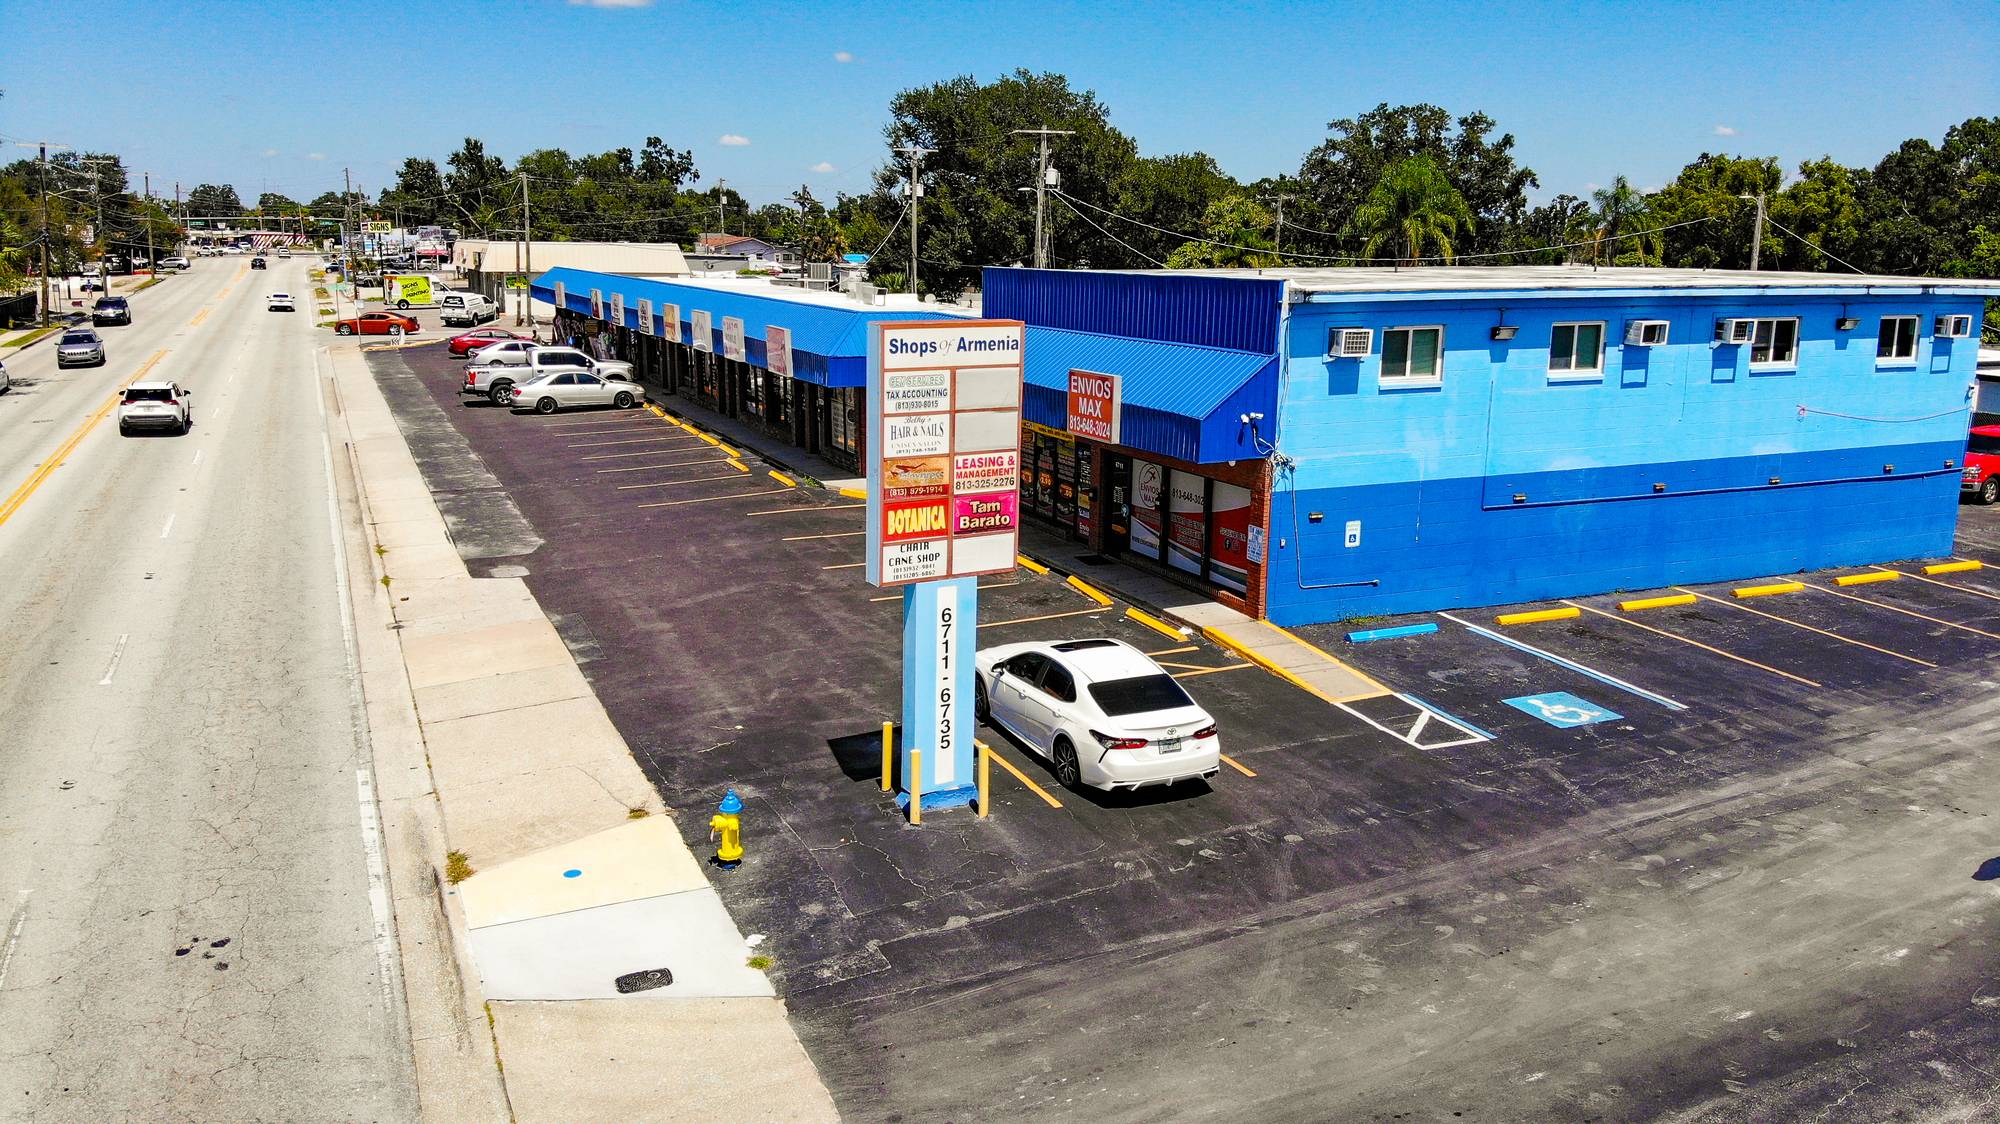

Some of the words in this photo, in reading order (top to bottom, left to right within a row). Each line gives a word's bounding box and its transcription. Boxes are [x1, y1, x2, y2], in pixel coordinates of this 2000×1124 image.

[369, 222, 390, 231] SIGNS
[889, 337, 937, 357] Shops
[957, 335, 1019, 353] Armenia
[886, 391, 900, 400] TAX
[902, 388, 948, 399] ACCOUNTING
[1071, 375, 1111, 399] ENVIOS
[1078, 397, 1102, 418] MAX
[890, 425, 911, 441] HAIR
[912, 426, 919, 437] &
[921, 422, 944, 437] NAILS
[1069, 415, 1111, 438] 813-648-3024
[956, 456, 1004, 470] LEASING
[1007, 456, 1015, 466] &
[956, 467, 1015, 479] MANAGEMENT
[956, 477, 1015, 490] 813-325-2276
[889, 488, 907, 497] (813)
[970, 501, 1001, 513] Tam
[887, 505, 946, 535] BOTANICA
[960, 513, 1010, 529] Barato
[900, 542, 929, 553] CHAIR
[889, 555, 912, 567] CANE
[917, 552, 940, 563] SHOP
